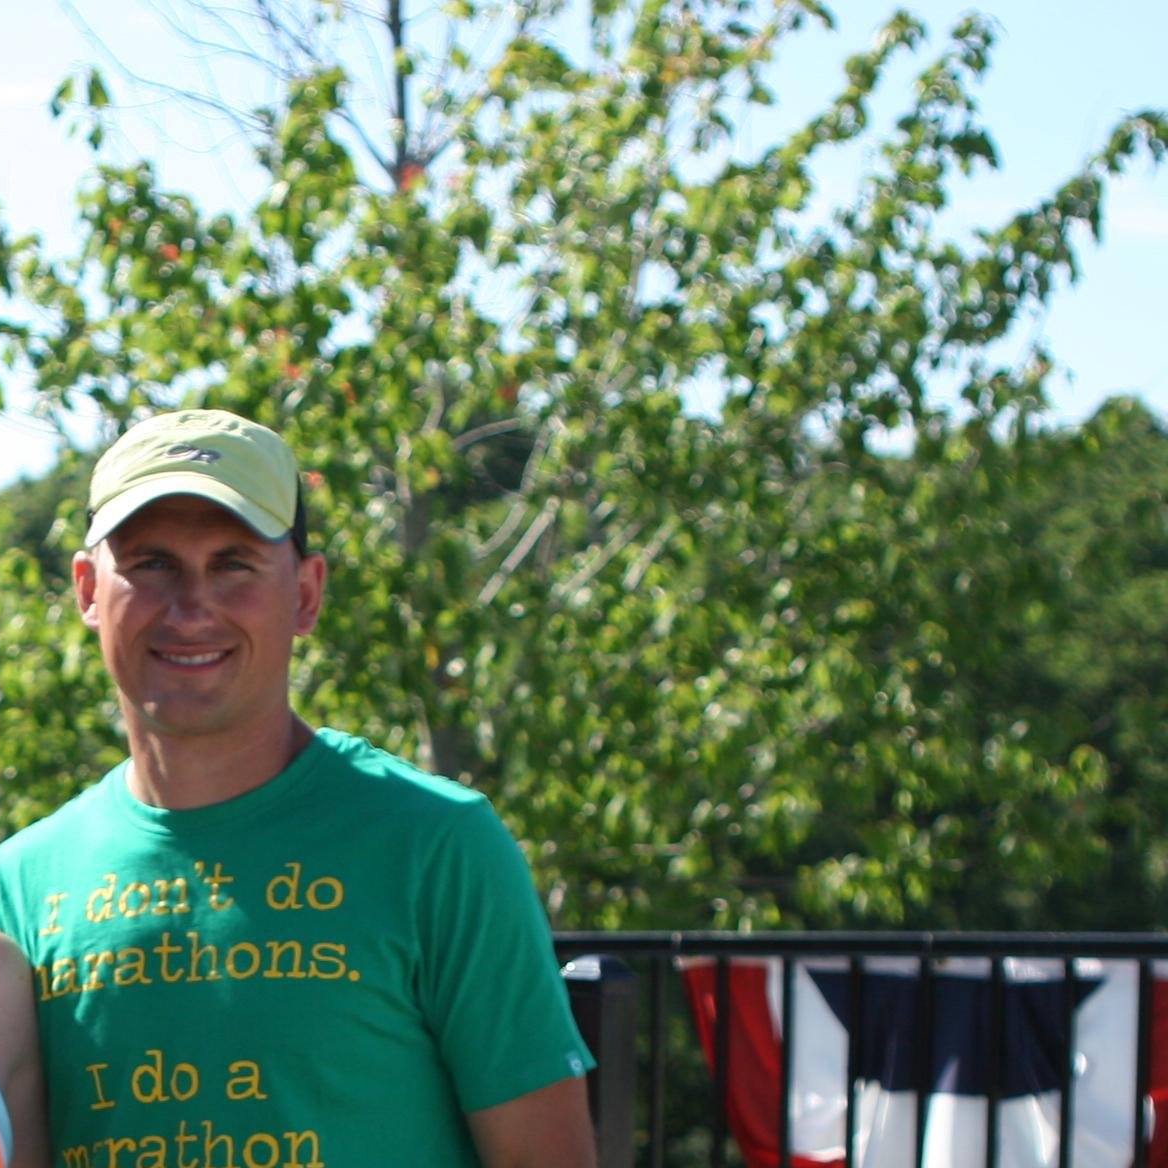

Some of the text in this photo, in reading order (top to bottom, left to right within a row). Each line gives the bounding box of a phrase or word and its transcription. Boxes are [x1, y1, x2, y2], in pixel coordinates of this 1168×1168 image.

[38, 861, 345, 937] I don't do
[86, 1049, 269, 1110] I do a
